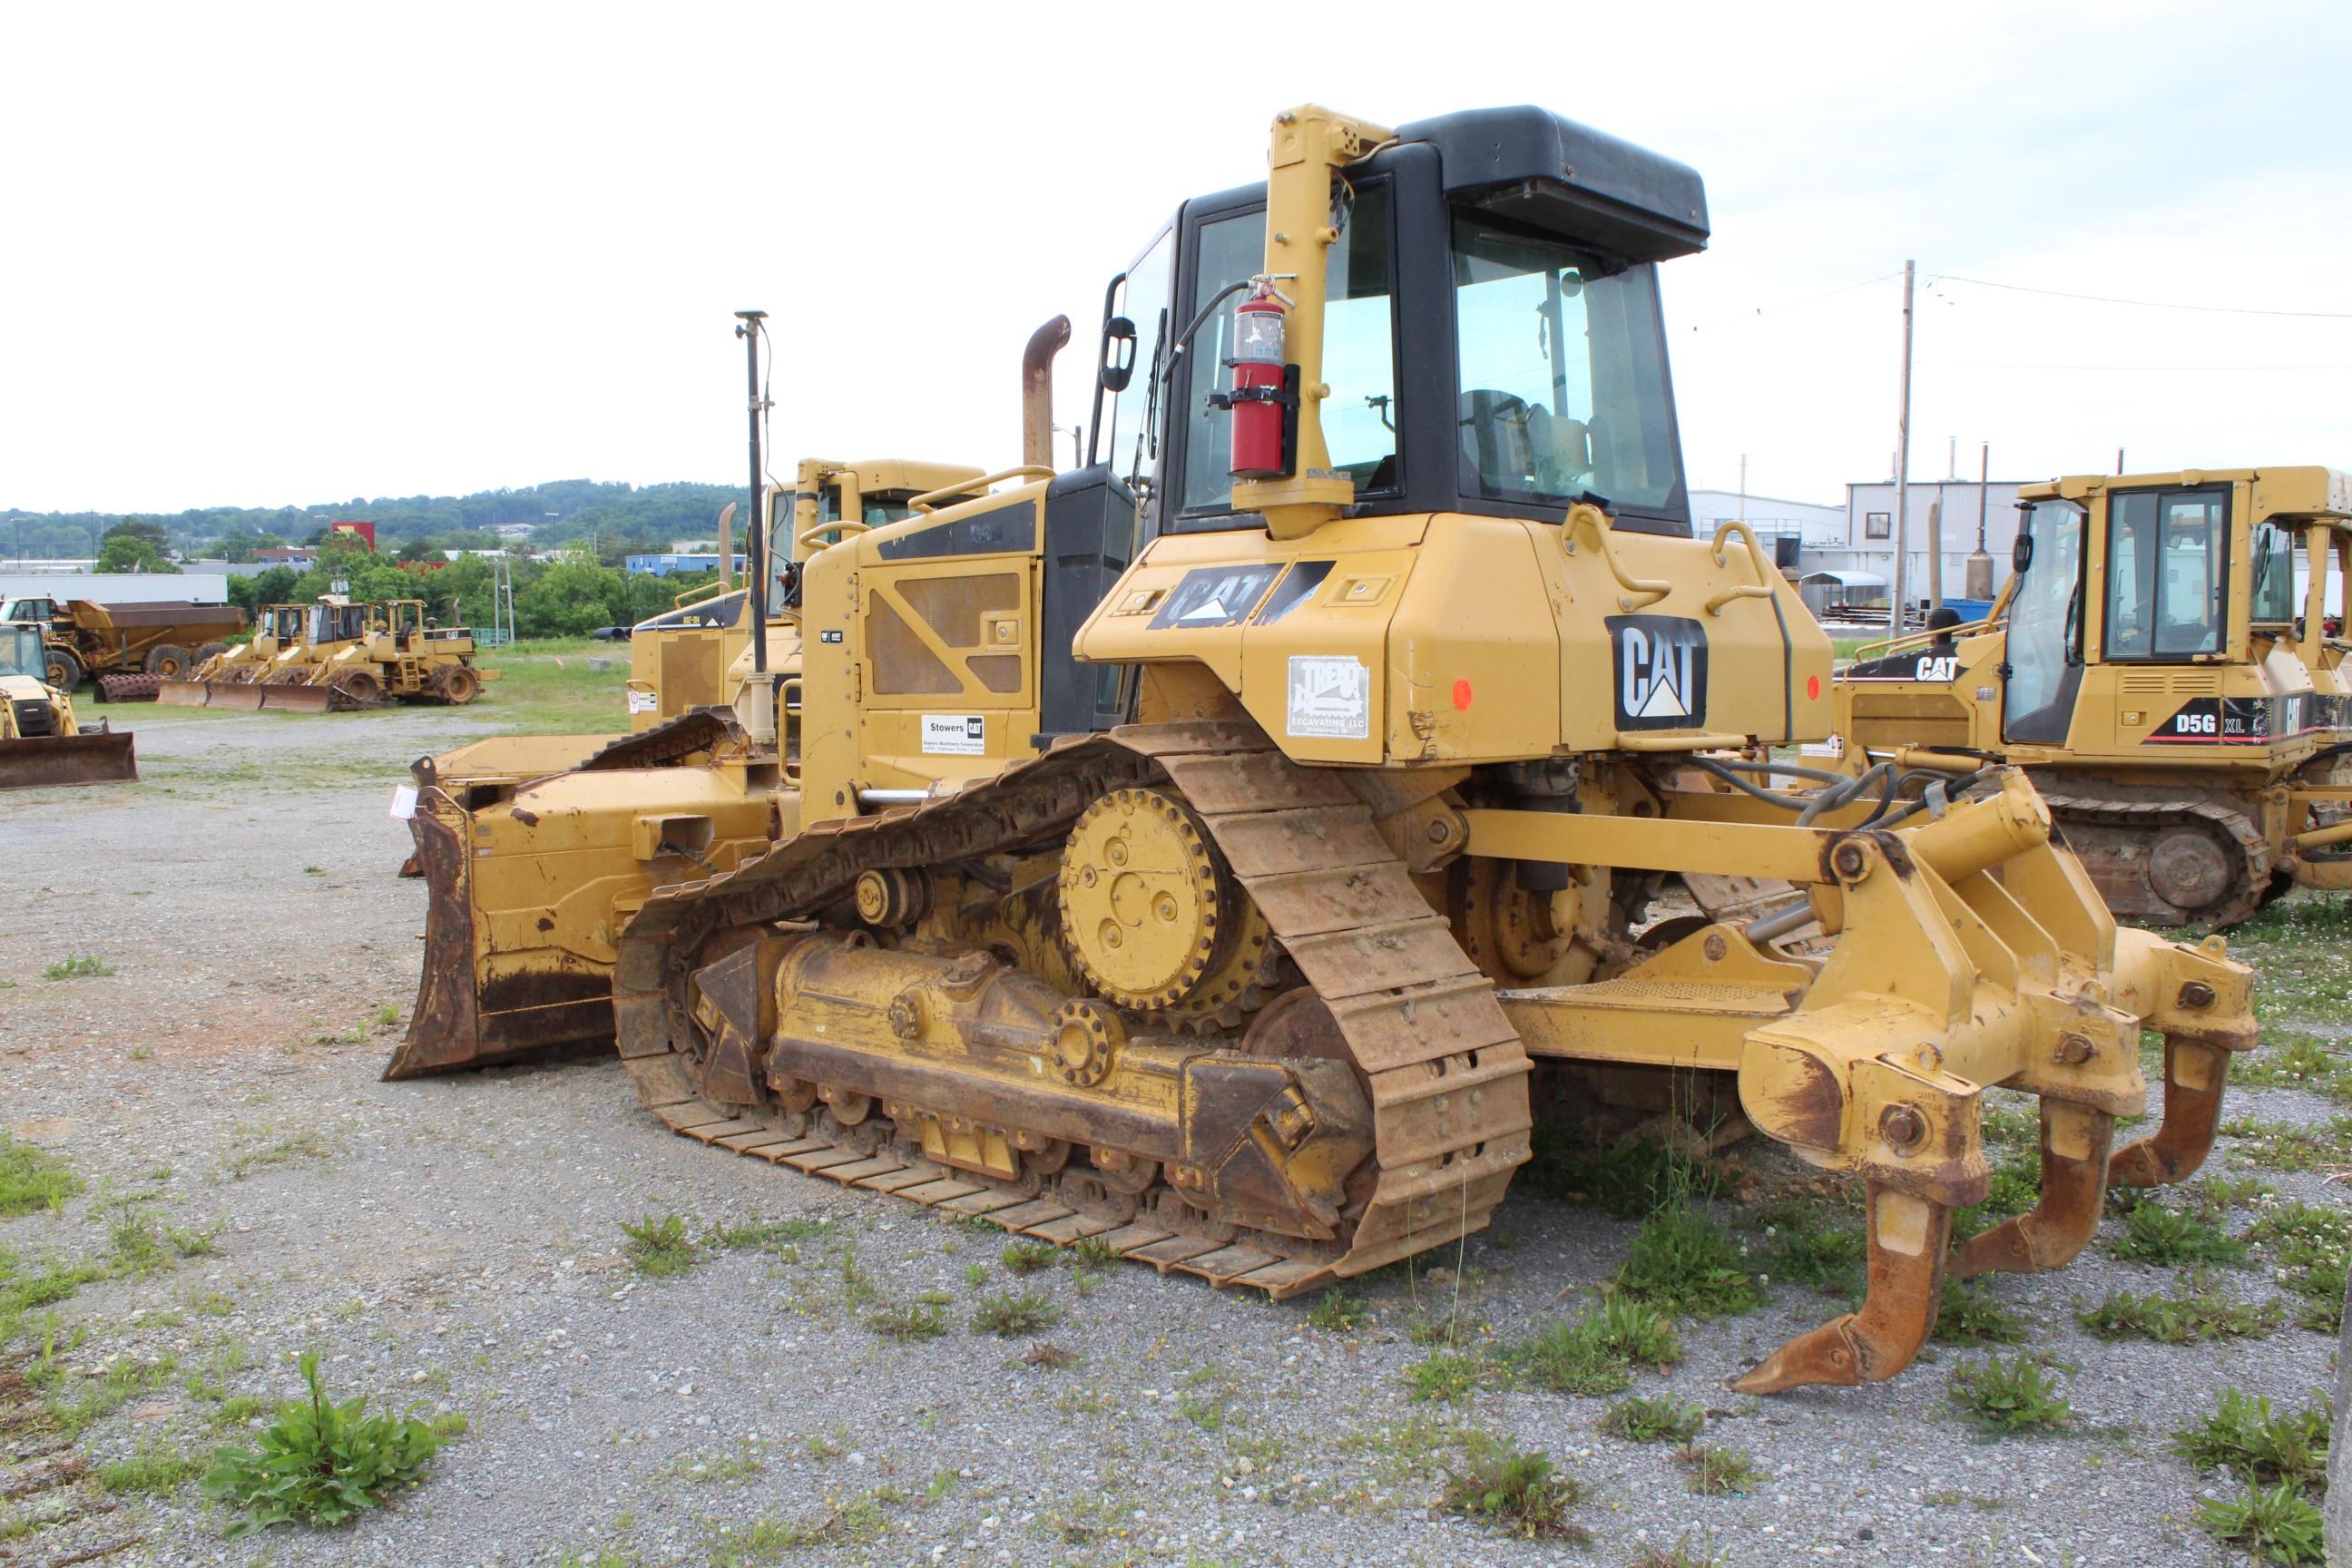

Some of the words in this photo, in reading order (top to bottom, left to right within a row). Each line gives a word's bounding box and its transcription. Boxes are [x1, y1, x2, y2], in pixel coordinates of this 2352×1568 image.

[1167, 573, 1267, 622] CAT
[446, 631, 459, 640] CAT
[1622, 627, 1699, 717] CAT
[1916, 656, 1960, 681] CAT
[930, 722, 965, 732] Stowers
[1291, 718, 1346, 728] EXCAVATING
[1348, 720, 1366, 728] LLC
[2176, 714, 2216, 733] D5G
[2224, 718, 2246, 734] XL
[2287, 698, 2301, 736] CAT
[968, 722, 982, 734] CAT
